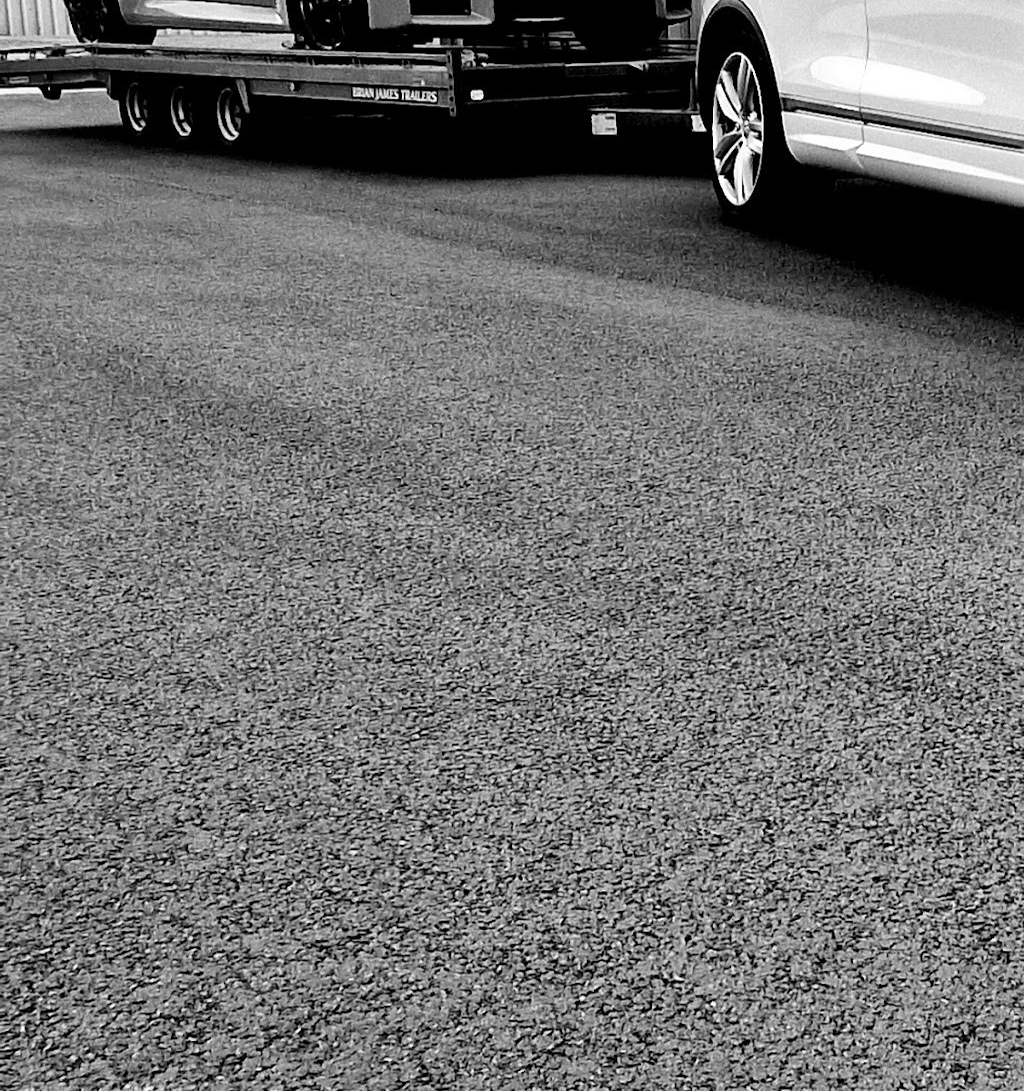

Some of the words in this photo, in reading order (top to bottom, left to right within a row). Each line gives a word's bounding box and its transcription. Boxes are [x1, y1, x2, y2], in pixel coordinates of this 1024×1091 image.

[352, 87, 374, 98] BRIAN
[374, 88, 399, 101] JAMES
[401, 89, 437, 103] TRAILERS
